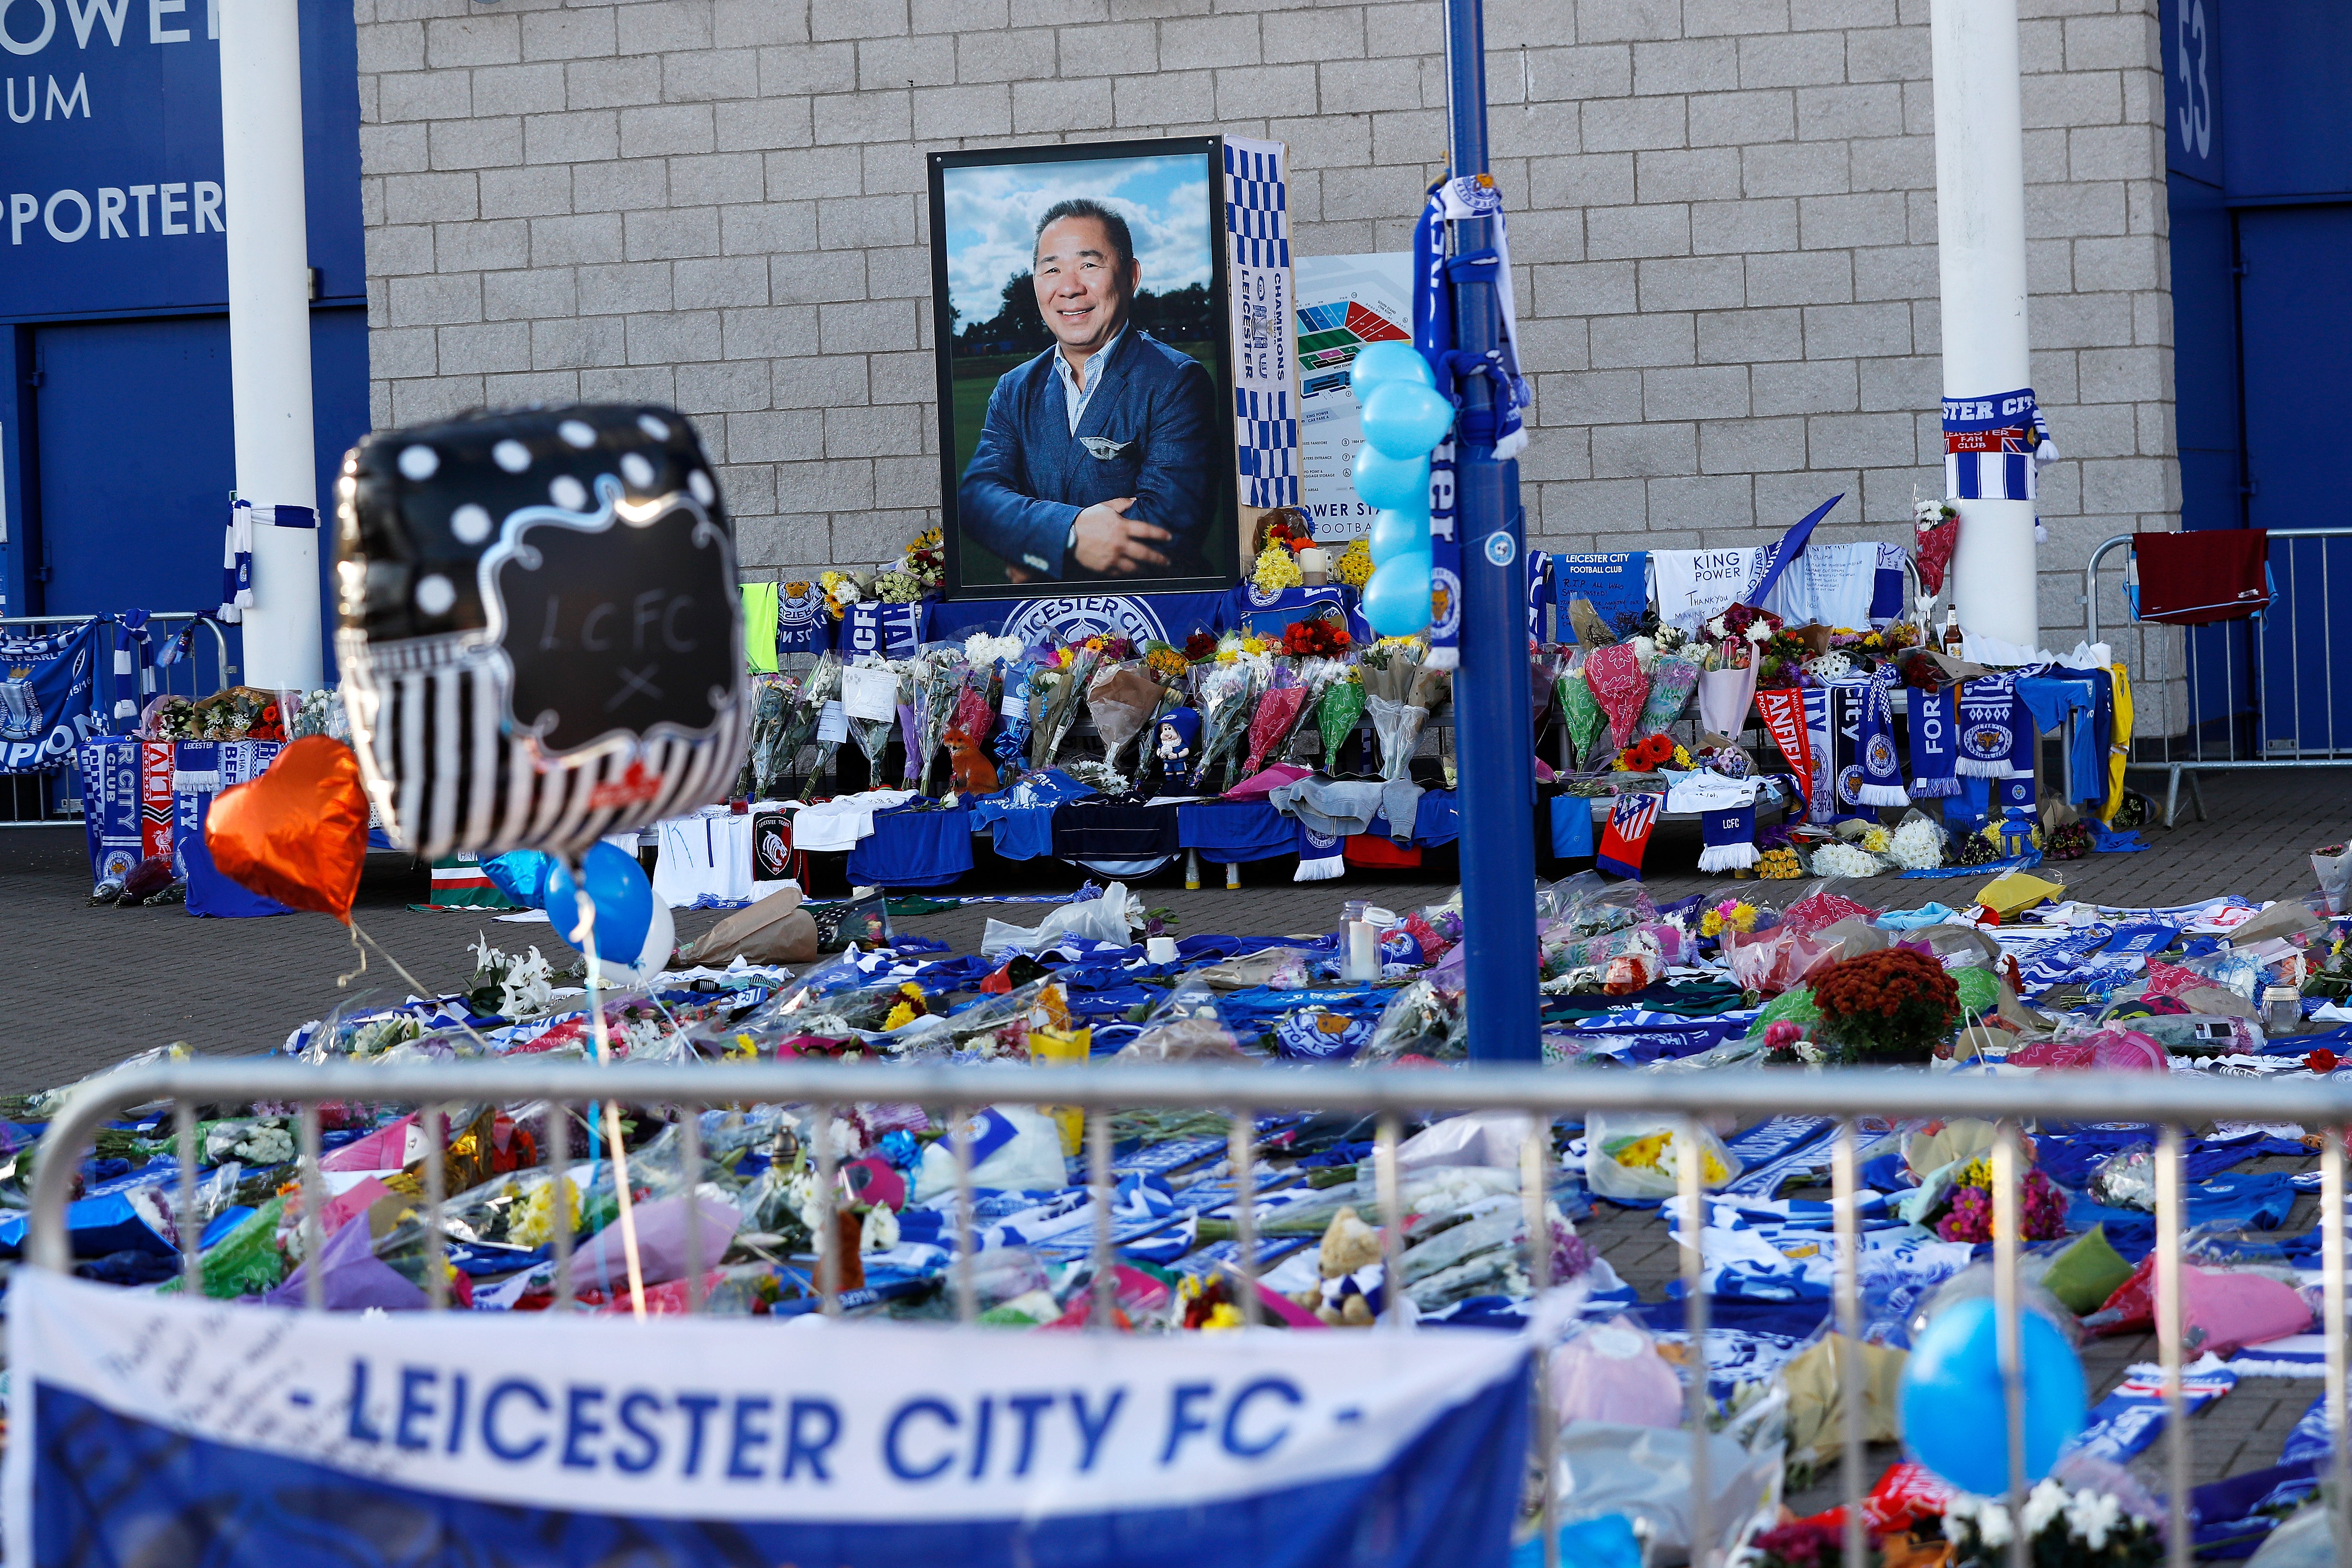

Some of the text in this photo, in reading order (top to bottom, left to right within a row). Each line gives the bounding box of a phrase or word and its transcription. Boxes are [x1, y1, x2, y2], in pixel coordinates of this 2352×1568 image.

[7, 72, 91, 124] UM
[2178, 0, 2210, 159] 53
[0, 181, 226, 245] PORTER
[1242, 270, 1253, 378] LEICESTER
[1274, 273, 1284, 381] CHAMPIONS
[1566, 554, 1630, 563] LEICESTER CITY
[1694, 552, 1740, 570] KING
[1695, 567, 1741, 582] POWER
[1792, 693, 1800, 714] WALK
[184, 741, 214, 750] LEICESTER
[107, 753, 116, 802] CLUB
[118, 769, 135, 831] CITY
[759, 820, 790, 828] LEICESTER TIGERS
[1723, 818, 1740, 829] LCFC
[345, 1357, 844, 1483] LEICESTER
[881, 1388, 1127, 1484] CITY
[1160, 1375, 1304, 1466] FC
